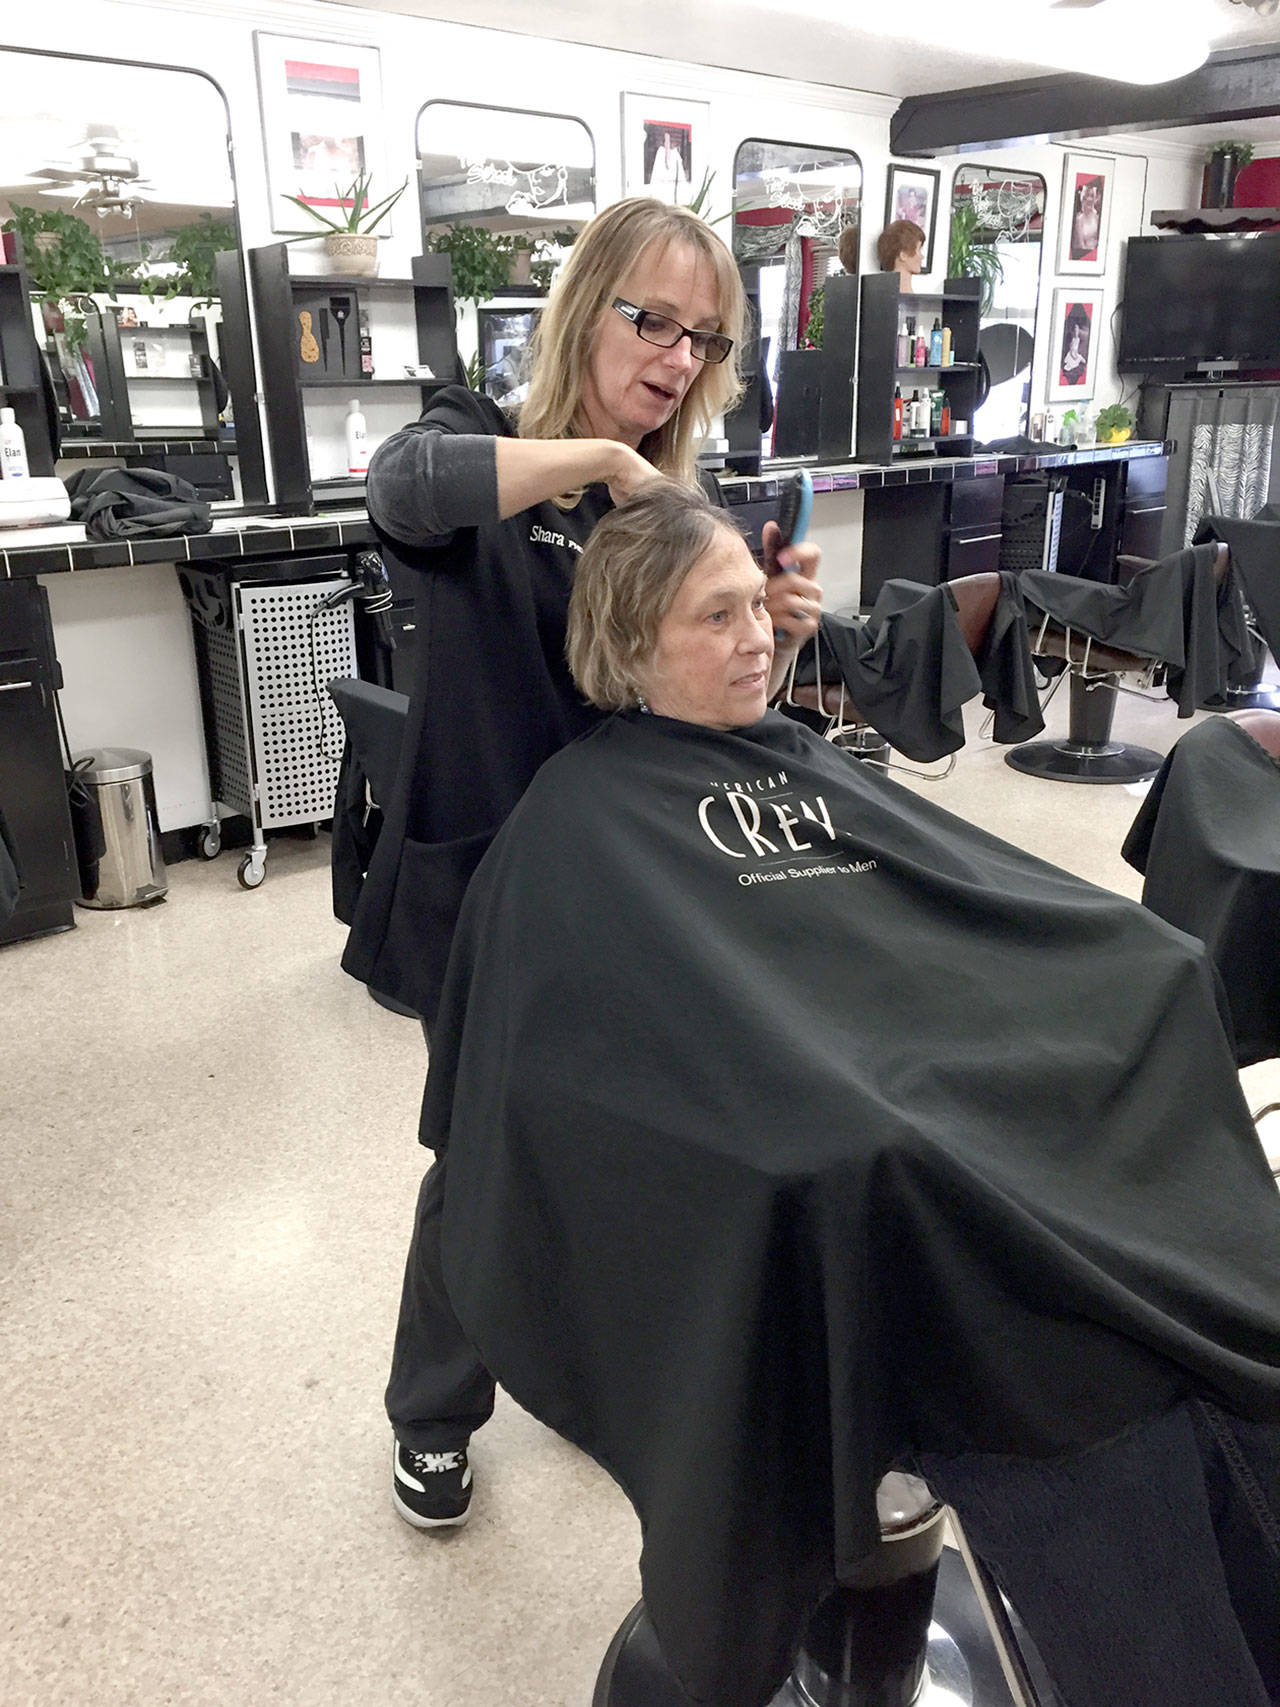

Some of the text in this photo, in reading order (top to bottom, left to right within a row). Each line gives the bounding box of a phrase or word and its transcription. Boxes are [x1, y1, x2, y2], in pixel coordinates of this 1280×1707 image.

[530, 525, 565, 547] Shara
[710, 771, 788, 793] ERICAN
[738, 860, 877, 887] Official Supplier to Men
